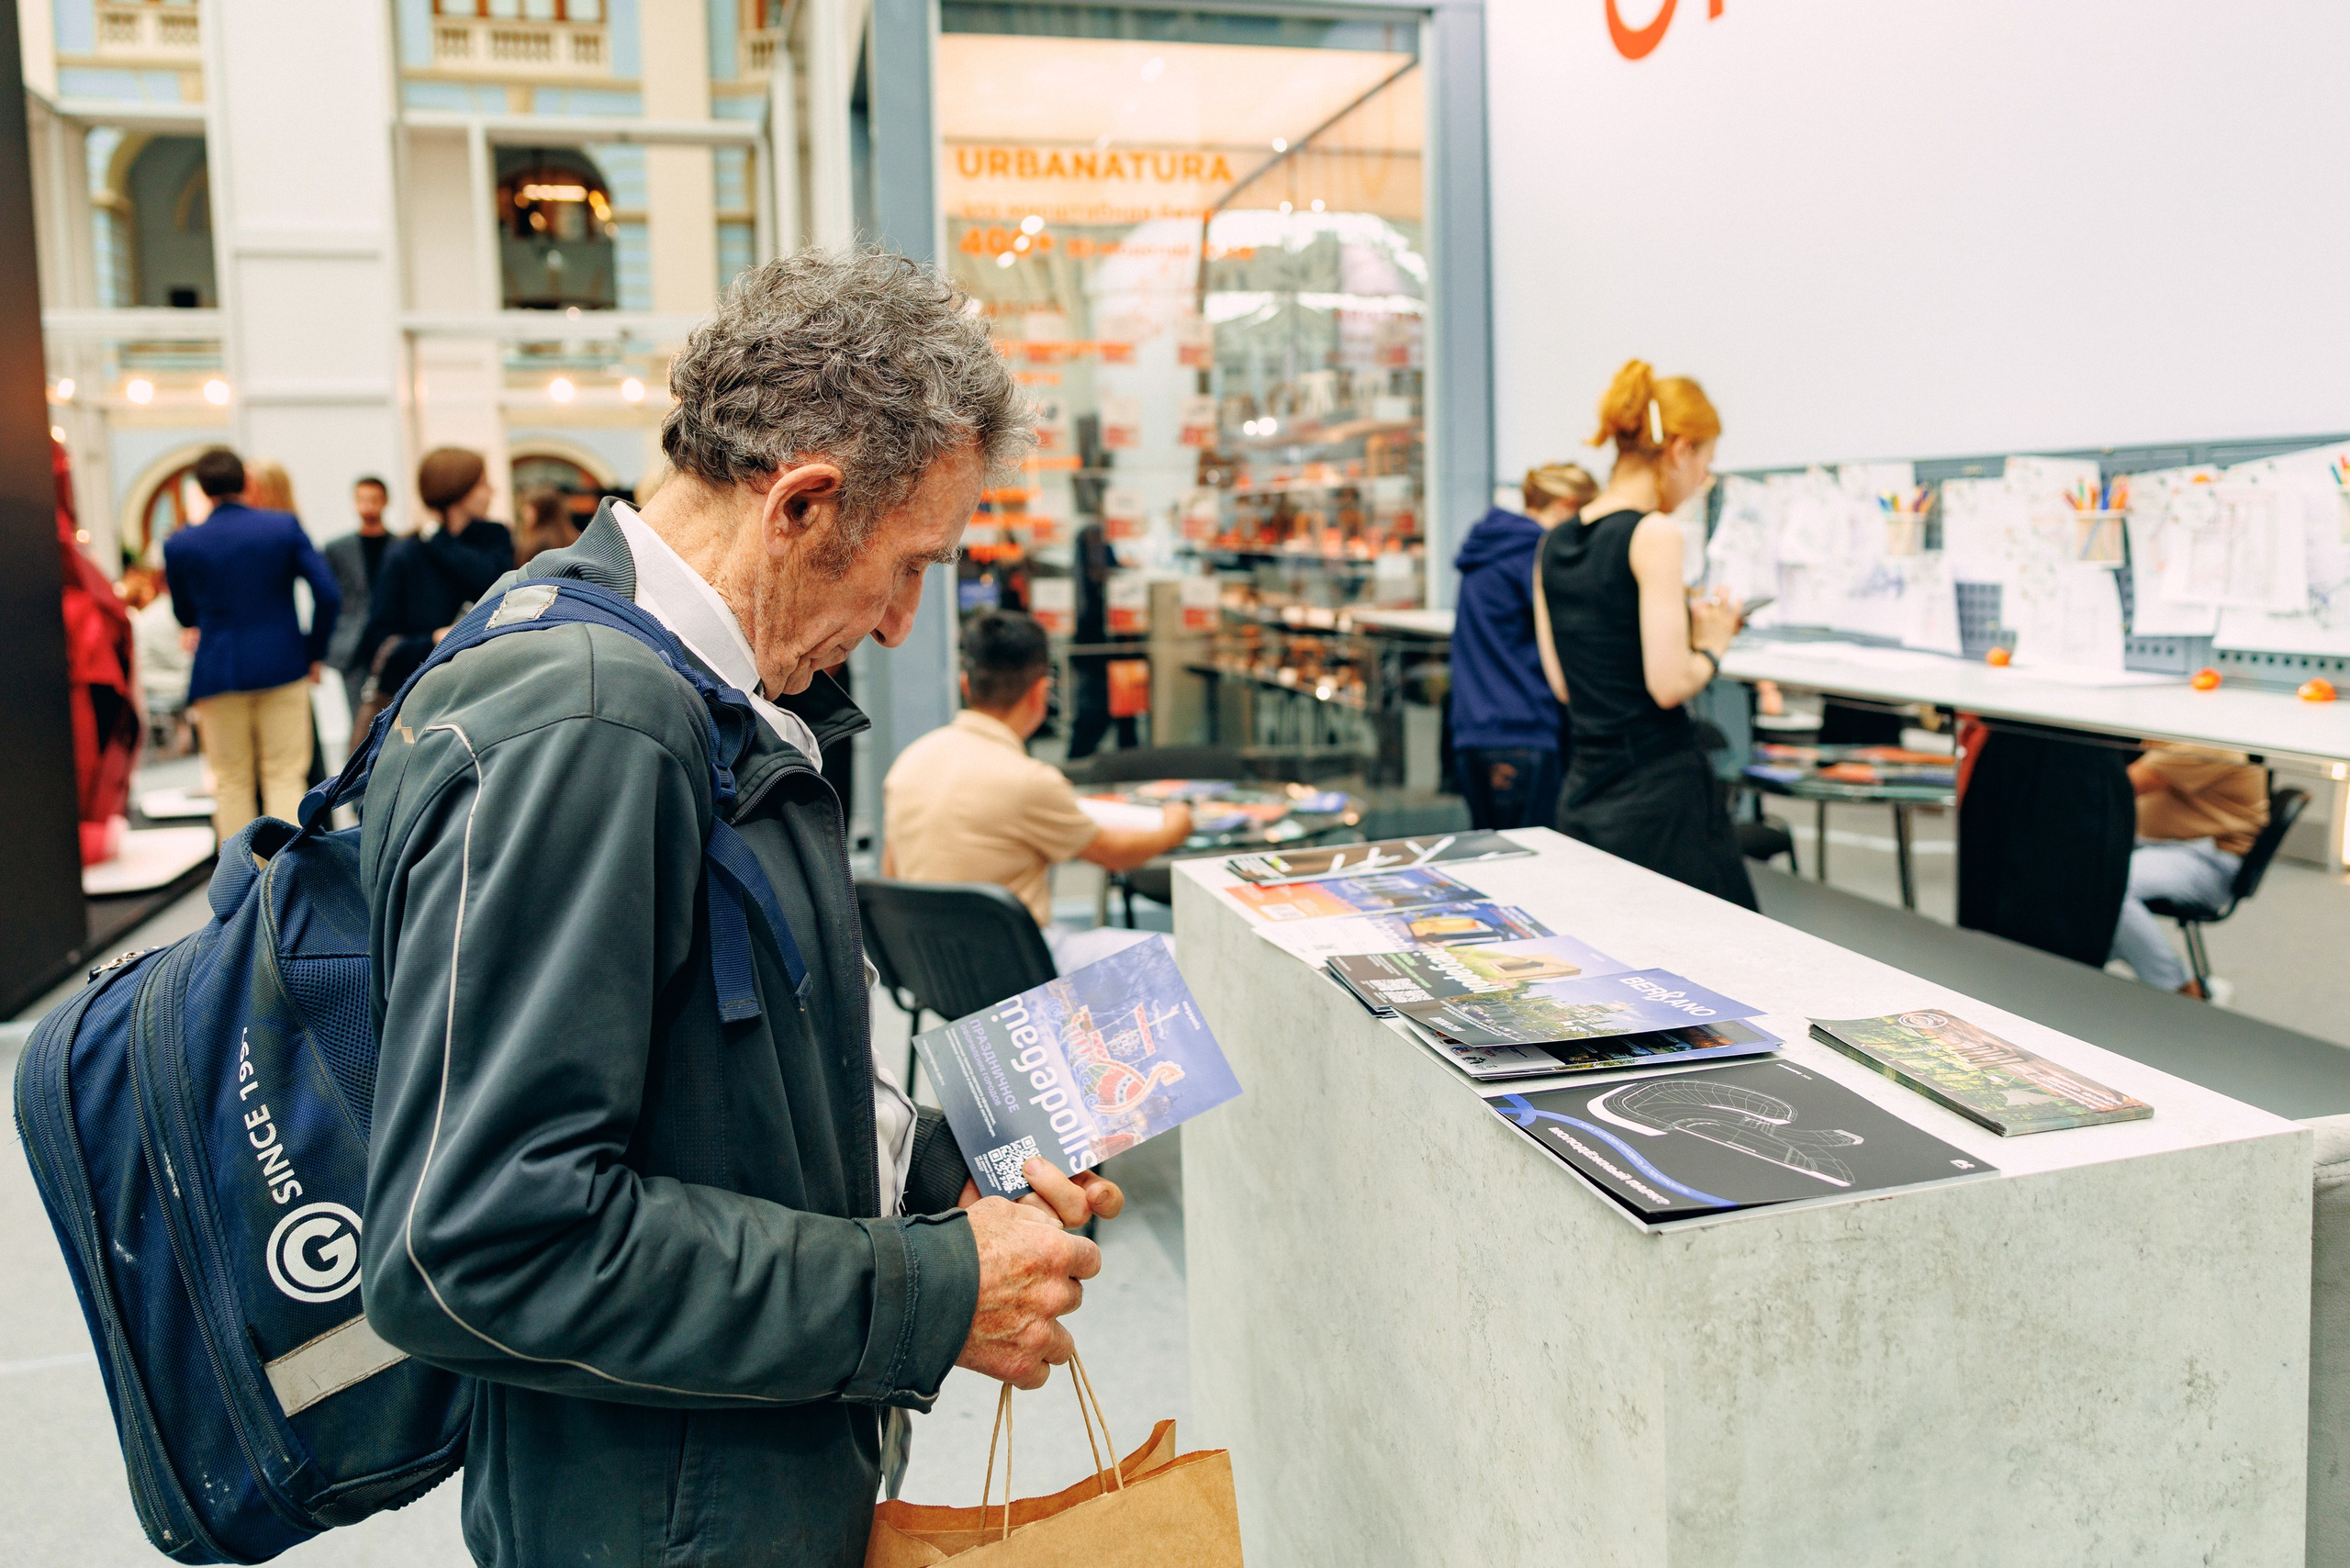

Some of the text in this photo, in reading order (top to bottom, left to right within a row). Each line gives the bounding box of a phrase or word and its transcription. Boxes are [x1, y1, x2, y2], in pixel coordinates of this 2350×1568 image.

[957, 149, 1235, 183] URBANATURA
[1413, 947, 1509, 994] megapoli
[1618, 977, 1717, 1016] BERKANO
[960, 1025, 1002, 1106] ОФОРМЛЕНИЕ ГОРОДОВ
[969, 1018, 1020, 1113] ПРАЗДНИЧНОЕ
[990, 995, 1098, 1174] megapolis
[245, 1103, 303, 1204] SINCE
[1548, 1126, 1633, 1182] МОЛОДЁЖНЫЙ
[283, 1217, 357, 1288] G
